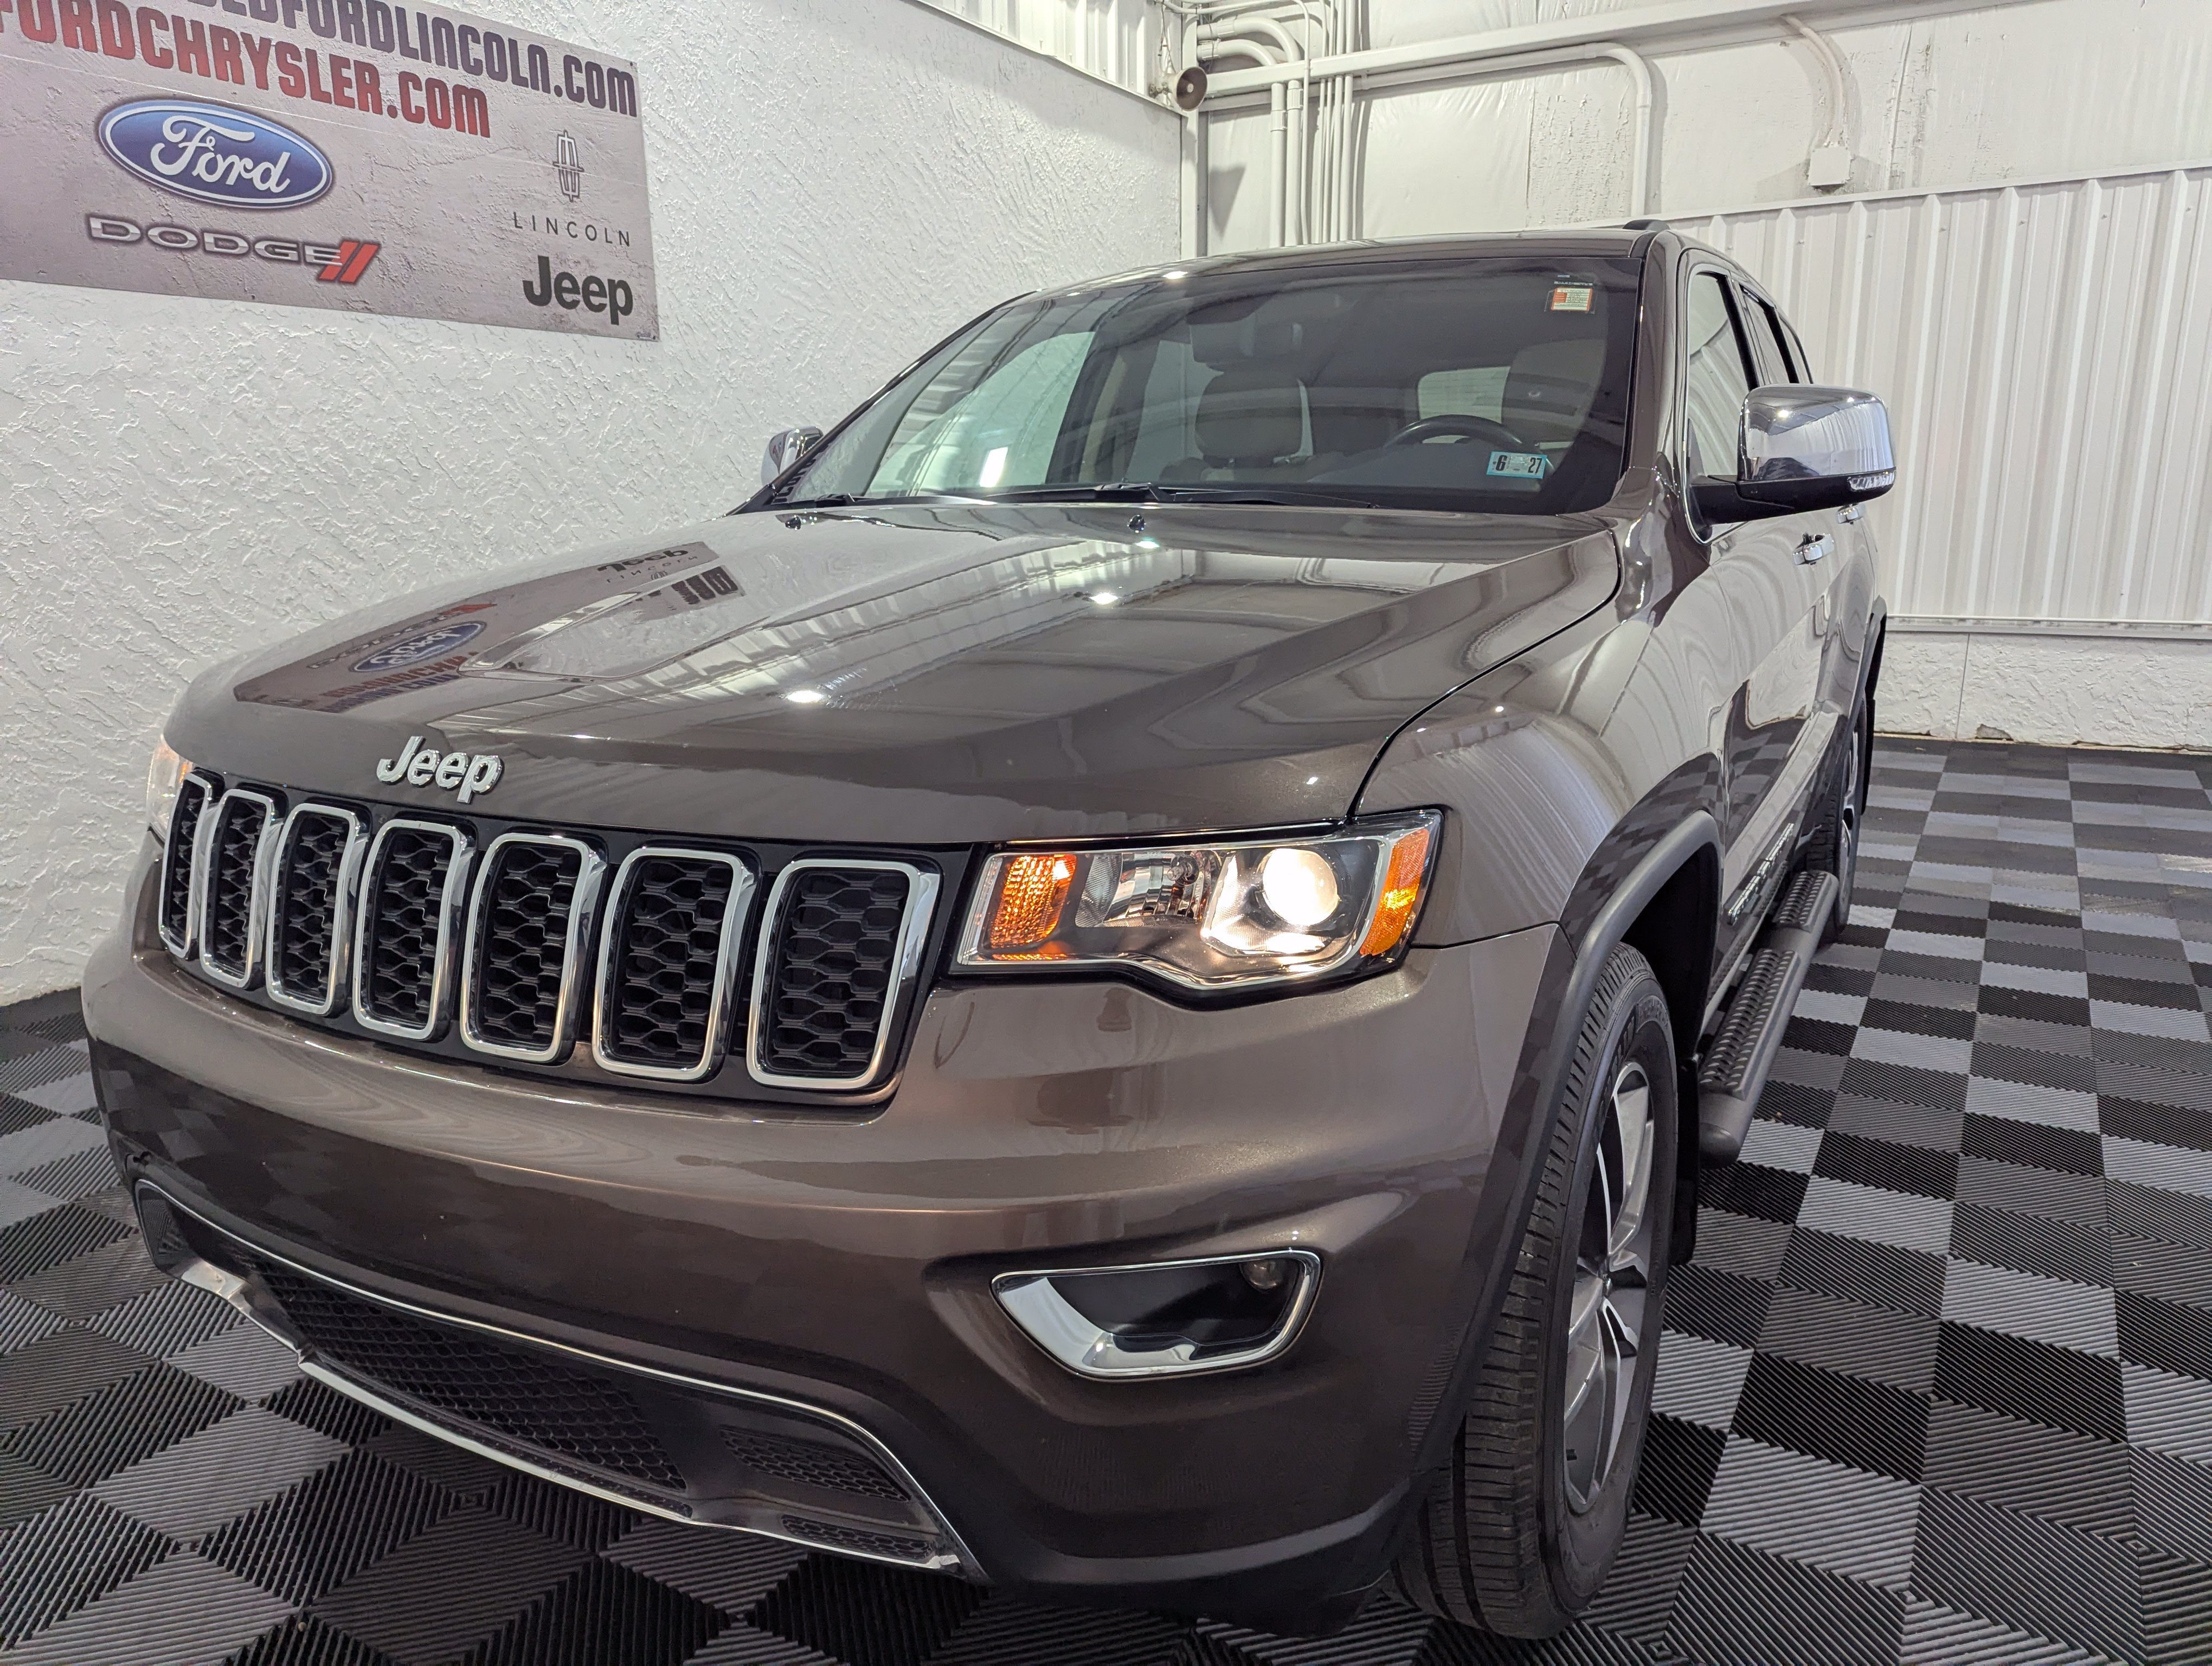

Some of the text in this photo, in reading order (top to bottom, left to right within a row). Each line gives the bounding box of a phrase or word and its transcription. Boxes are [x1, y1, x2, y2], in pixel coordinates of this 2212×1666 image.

[150, 115, 291, 194] Ford
[88, 216, 343, 267] DODGE
[513, 212, 630, 247] LINCOLN
[522, 254, 633, 325] Jeep
[1495, 454, 1508, 471] 6
[1527, 457, 1543, 474] 27
[376, 735, 503, 804] Jeep
